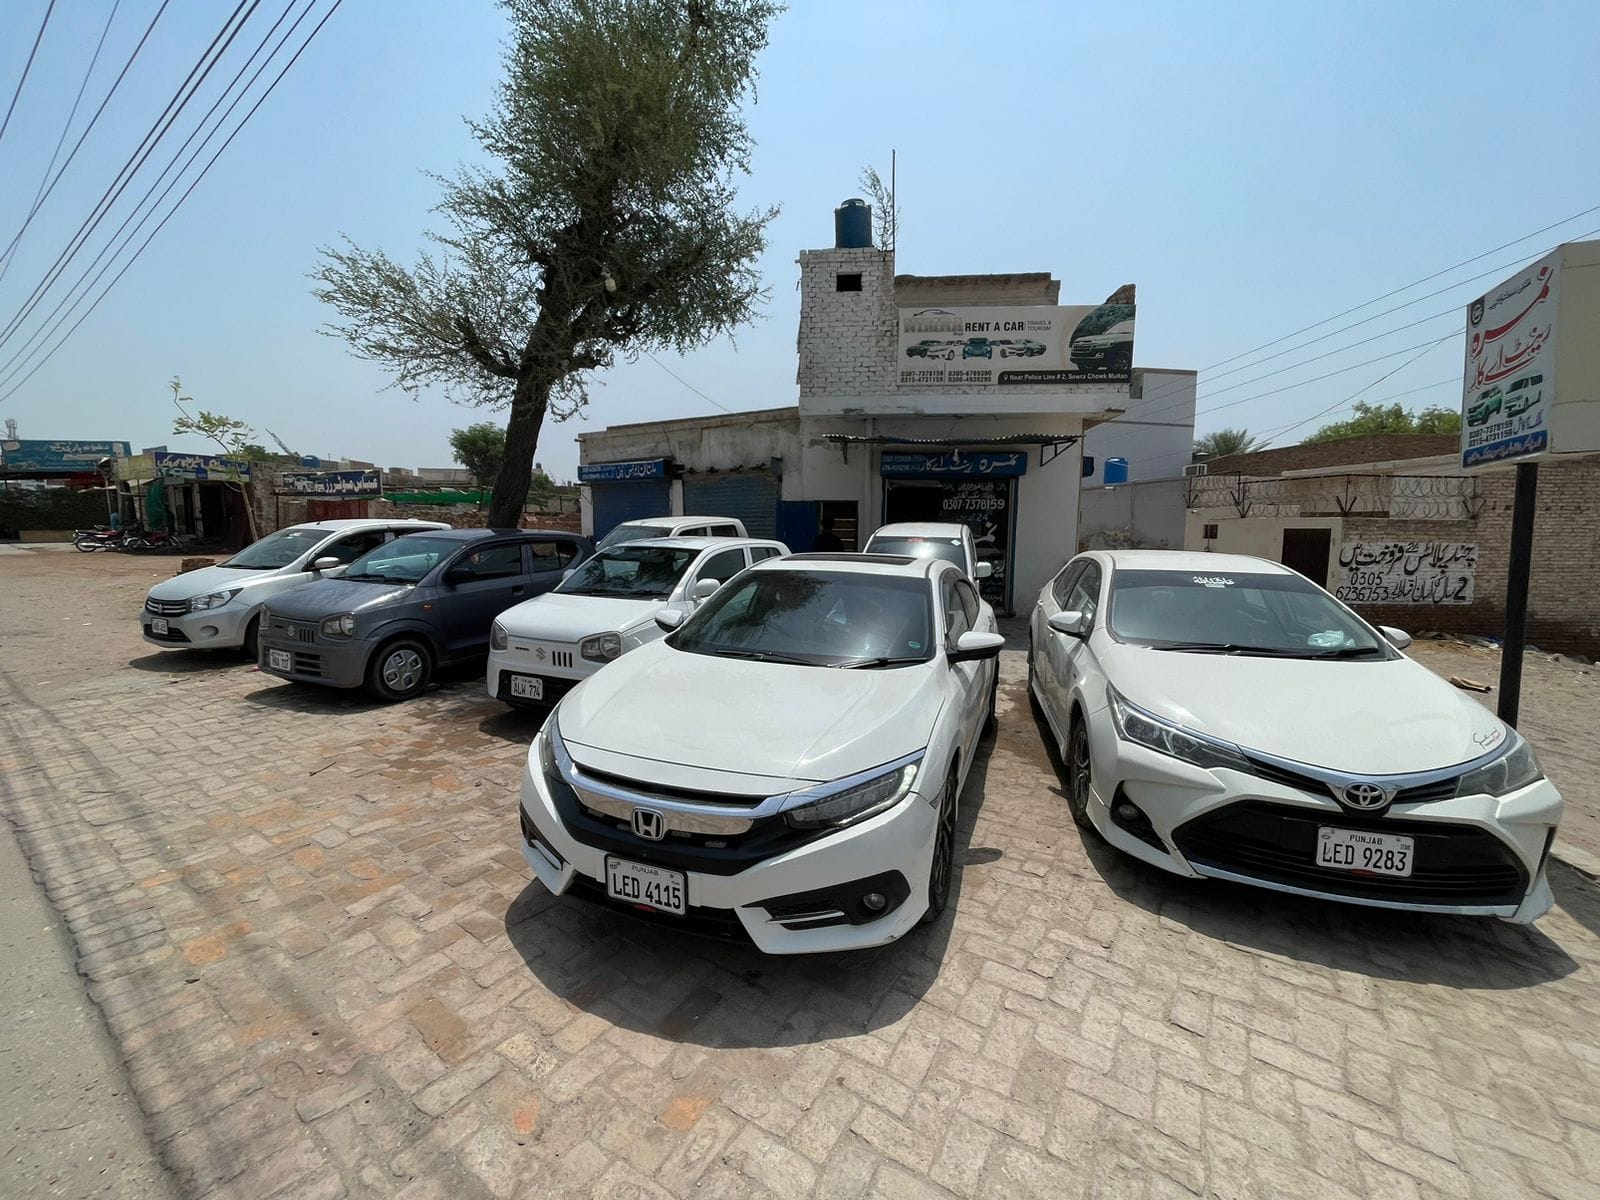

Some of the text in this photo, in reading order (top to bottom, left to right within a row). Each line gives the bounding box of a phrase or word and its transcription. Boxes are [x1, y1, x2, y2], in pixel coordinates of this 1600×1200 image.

[965, 321, 1024, 331] RENT A CAR
[1351, 572, 1384, 586] 0305
[1454, 577, 1468, 600] 2
[1349, 834, 1383, 845] PUNJAB
[1322, 842, 1407, 872] LED 9283
[632, 864, 658, 876] PUNJAB
[613, 873, 681, 909] LED 4115
